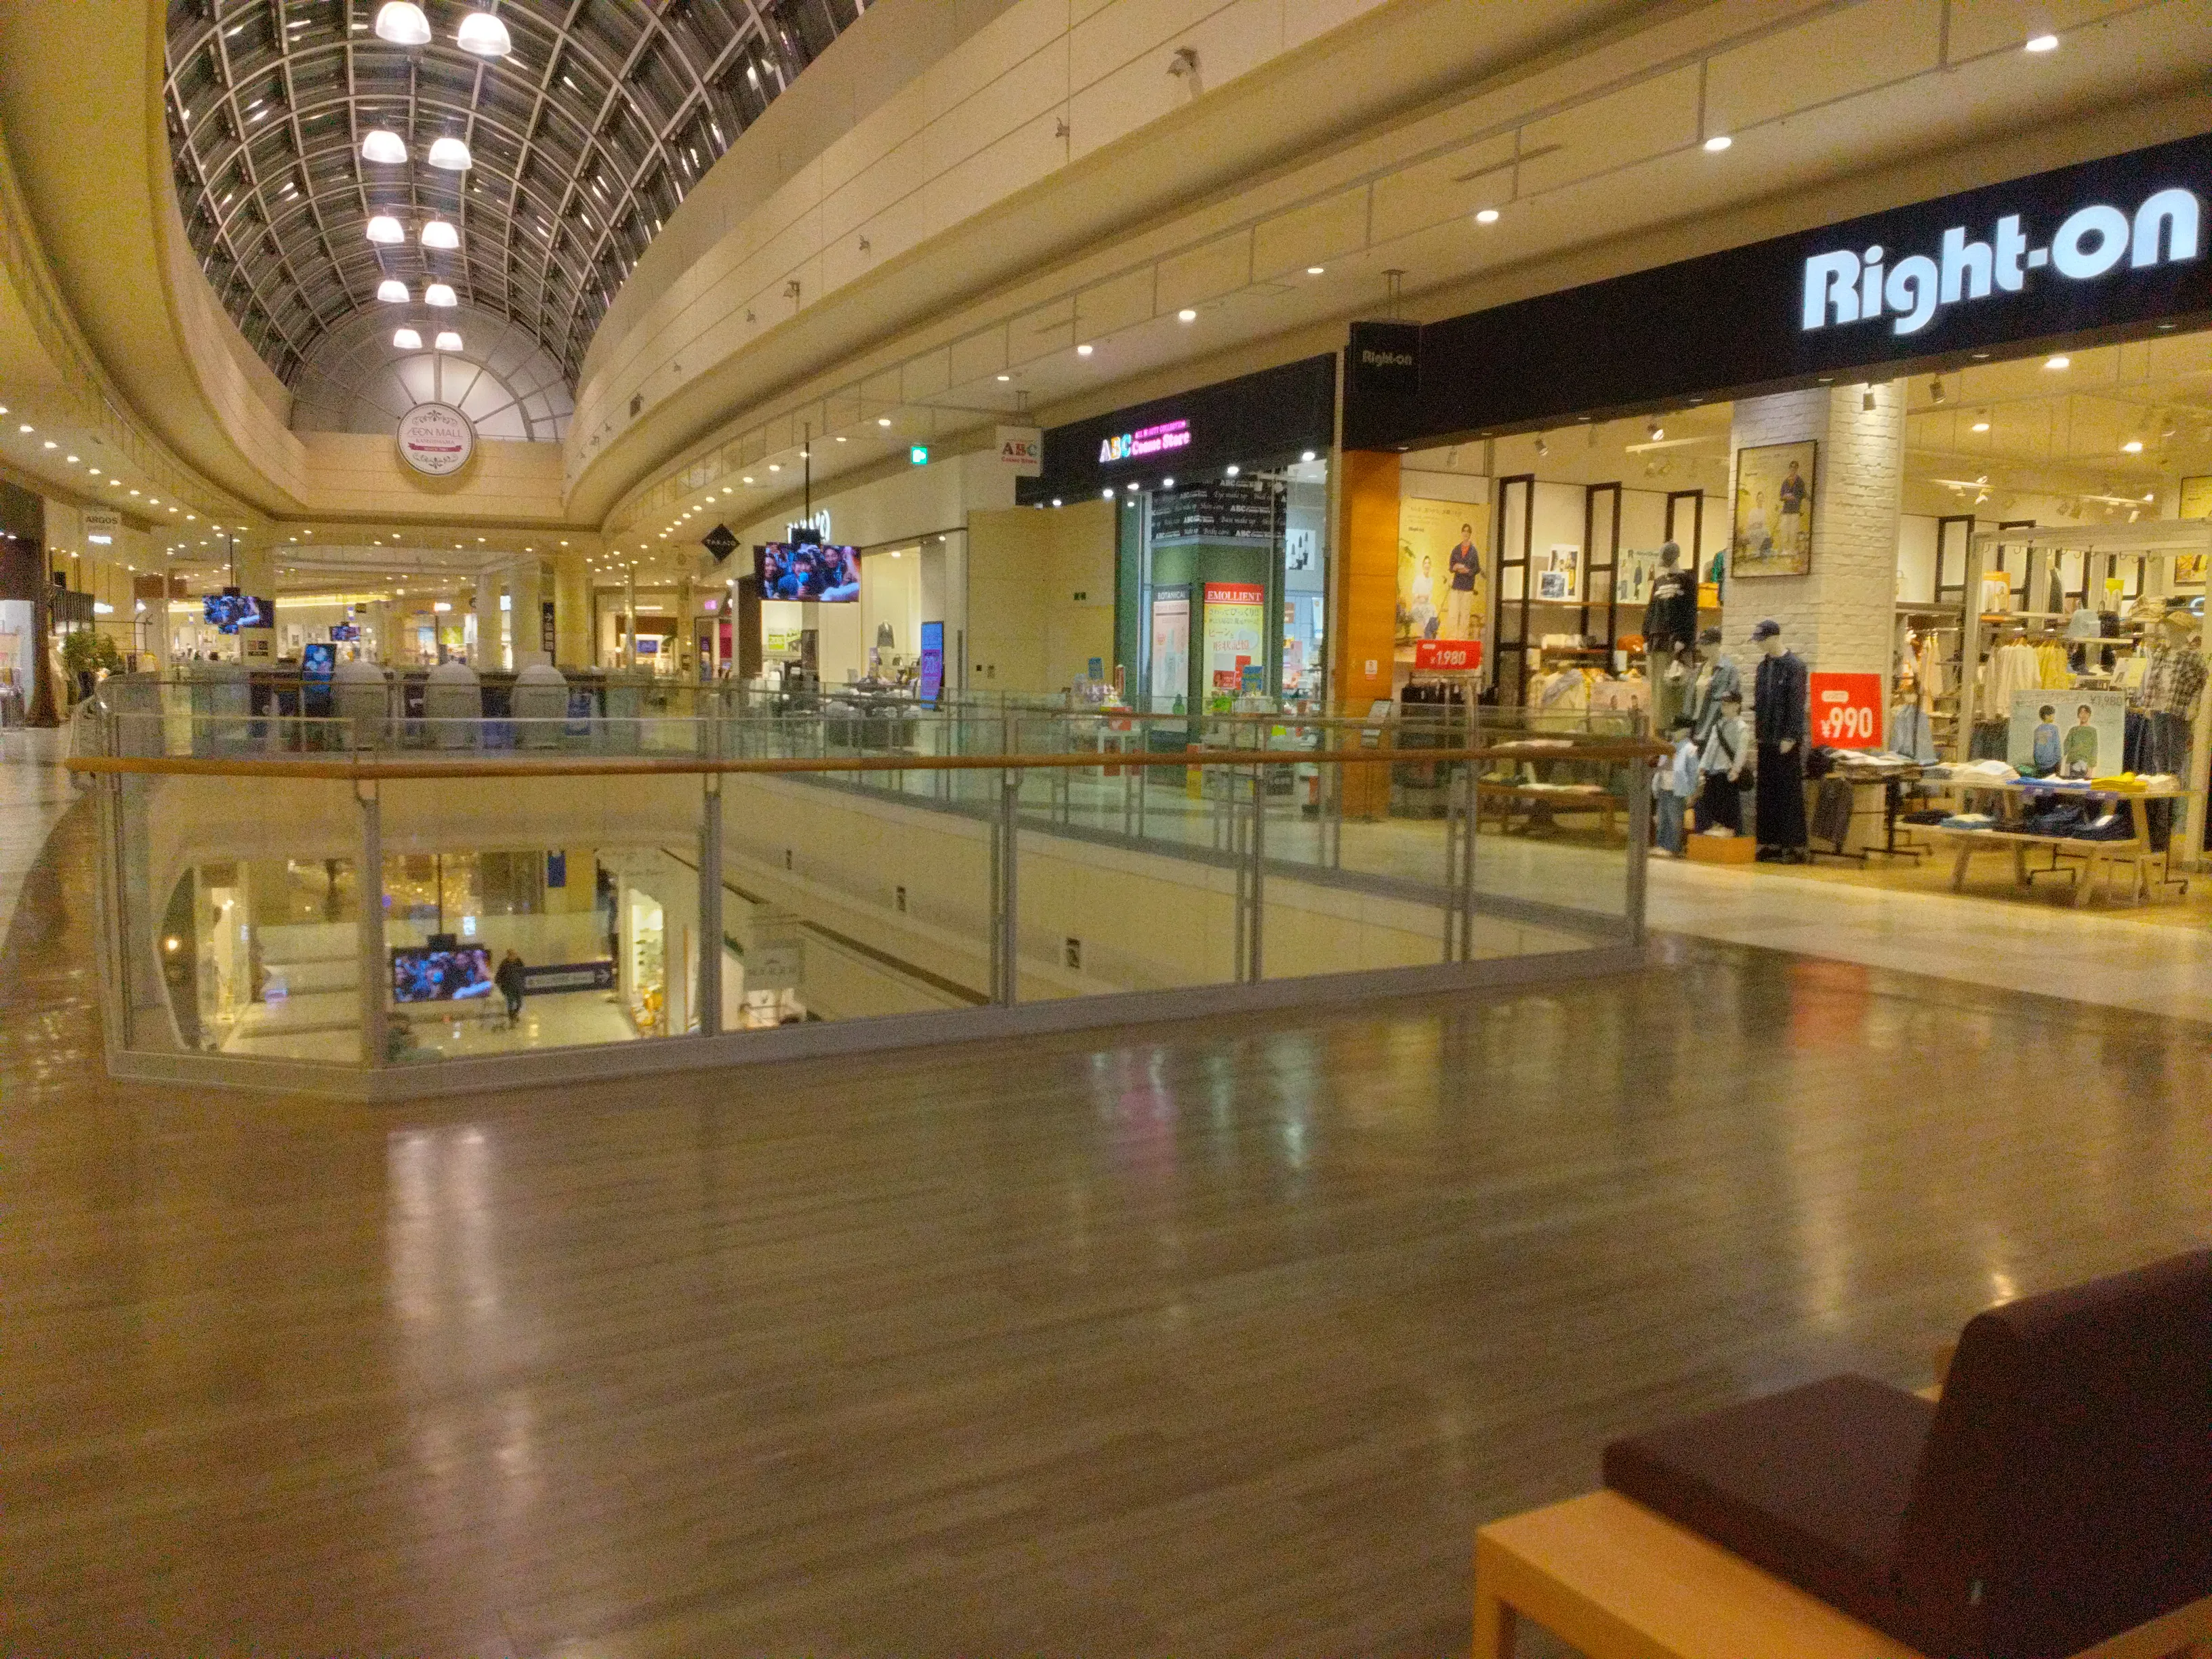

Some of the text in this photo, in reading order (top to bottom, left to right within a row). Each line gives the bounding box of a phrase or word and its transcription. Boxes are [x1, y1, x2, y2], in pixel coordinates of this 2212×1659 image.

[1803, 188, 2199, 335] Right-on
[1362, 350, 1412, 367] Right-on
[436, 428, 464, 438] MALL
[1002, 442, 1038, 457] ABC
[1099, 433, 1132, 462] ABC
[1162, 431, 1190, 449] Store
[1158, 591, 1185, 600] BOTANICAL
[1208, 591, 1262, 601] EMOLLIENT
[1820, 707, 1872, 738] ¥990
